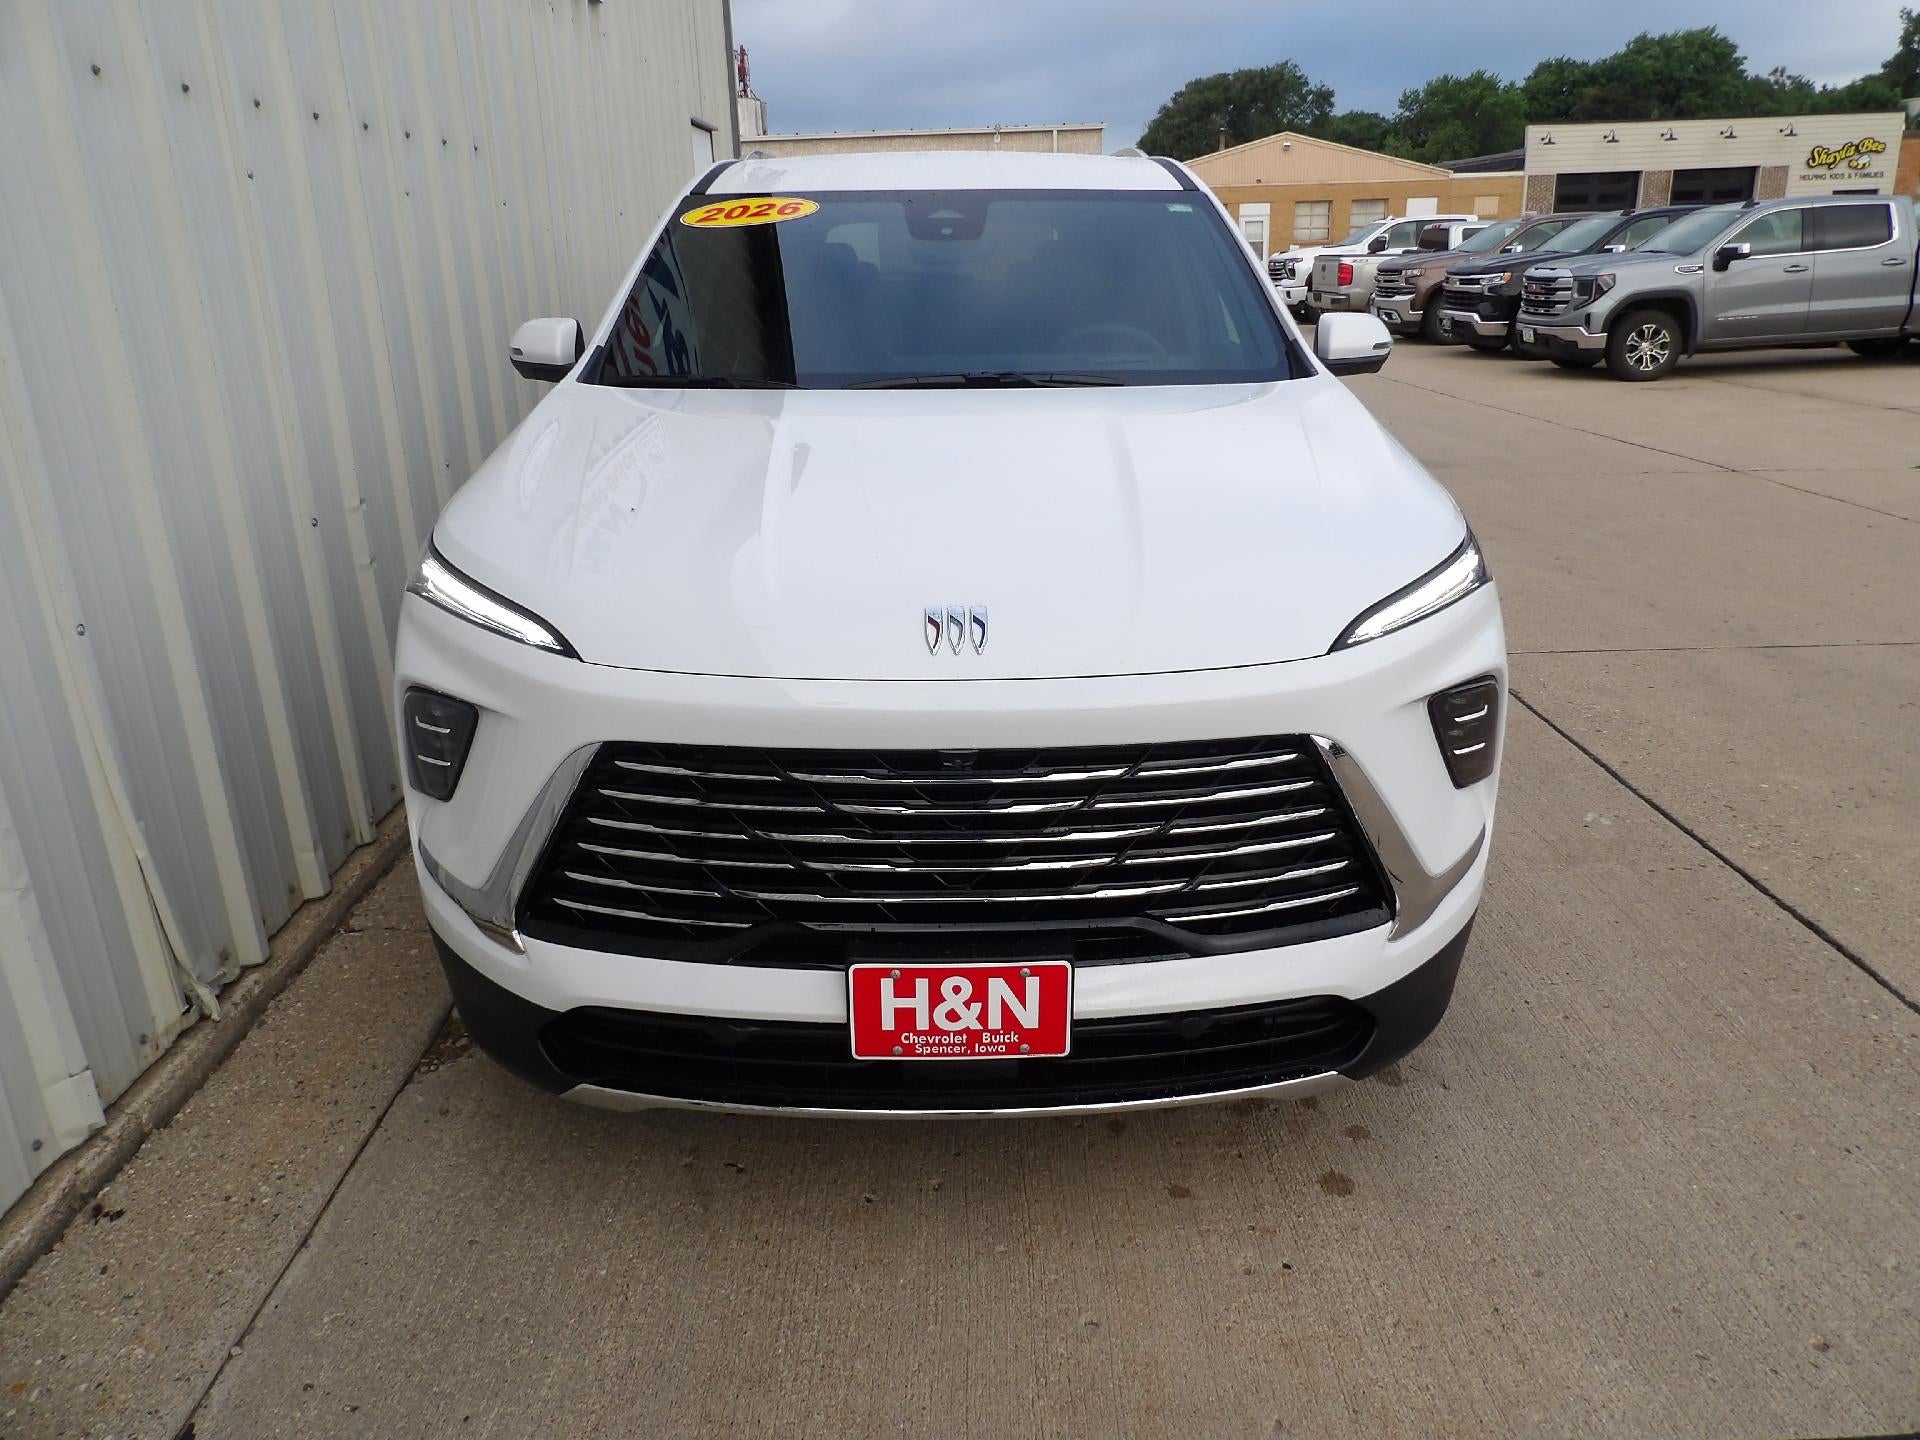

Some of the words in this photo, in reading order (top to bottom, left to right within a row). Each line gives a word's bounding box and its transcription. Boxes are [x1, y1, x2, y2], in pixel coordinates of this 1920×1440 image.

[1807, 142, 1857, 169] Shayla
[1858, 137, 1886, 153] Bee
[1799, 173, 1827, 181] HELPING
[695, 202, 804, 223] 2026
[880, 976, 1040, 1031] H&N
[900, 1032, 968, 1044] Chevrolet
[982, 1031, 1019, 1043] Buick
[915, 1043, 971, 1055] Spencer,
[974, 1043, 1006, 1053] Iowa
